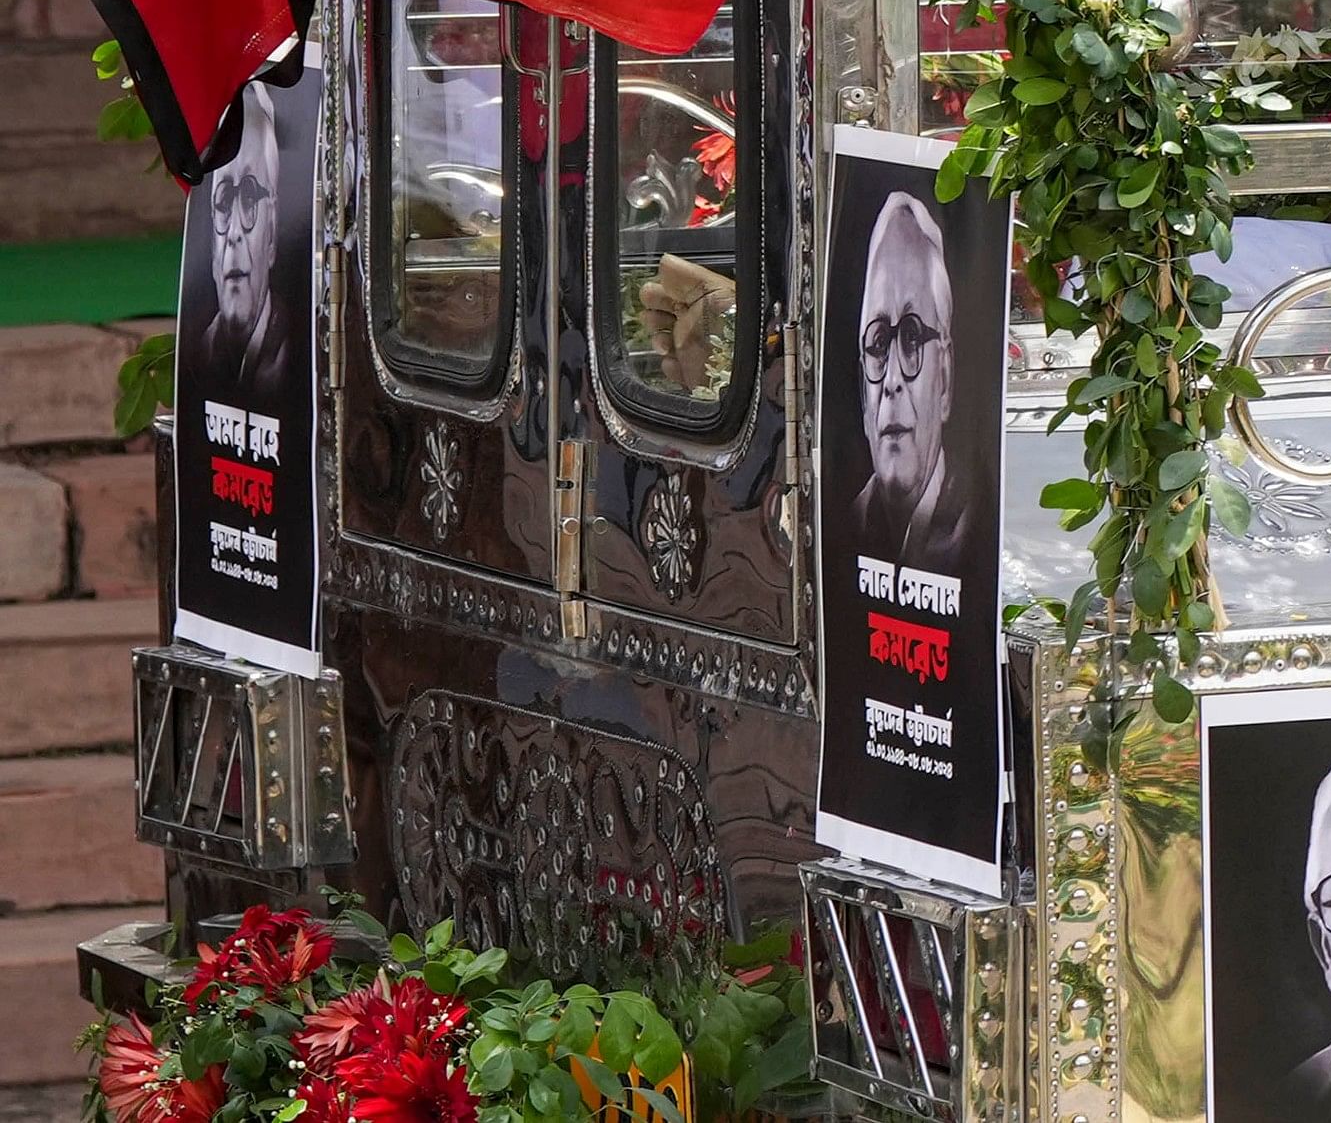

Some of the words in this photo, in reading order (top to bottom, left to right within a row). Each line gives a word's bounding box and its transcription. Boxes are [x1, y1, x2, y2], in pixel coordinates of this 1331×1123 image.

[204, 400, 246, 457] অমর
[248, 412, 280, 466] রহে
[211, 456, 275, 517] কমরেড
[857, 555, 895, 604] লাল
[898, 566, 961, 617] সেলাম
[868, 611, 950, 684] কমরেড
